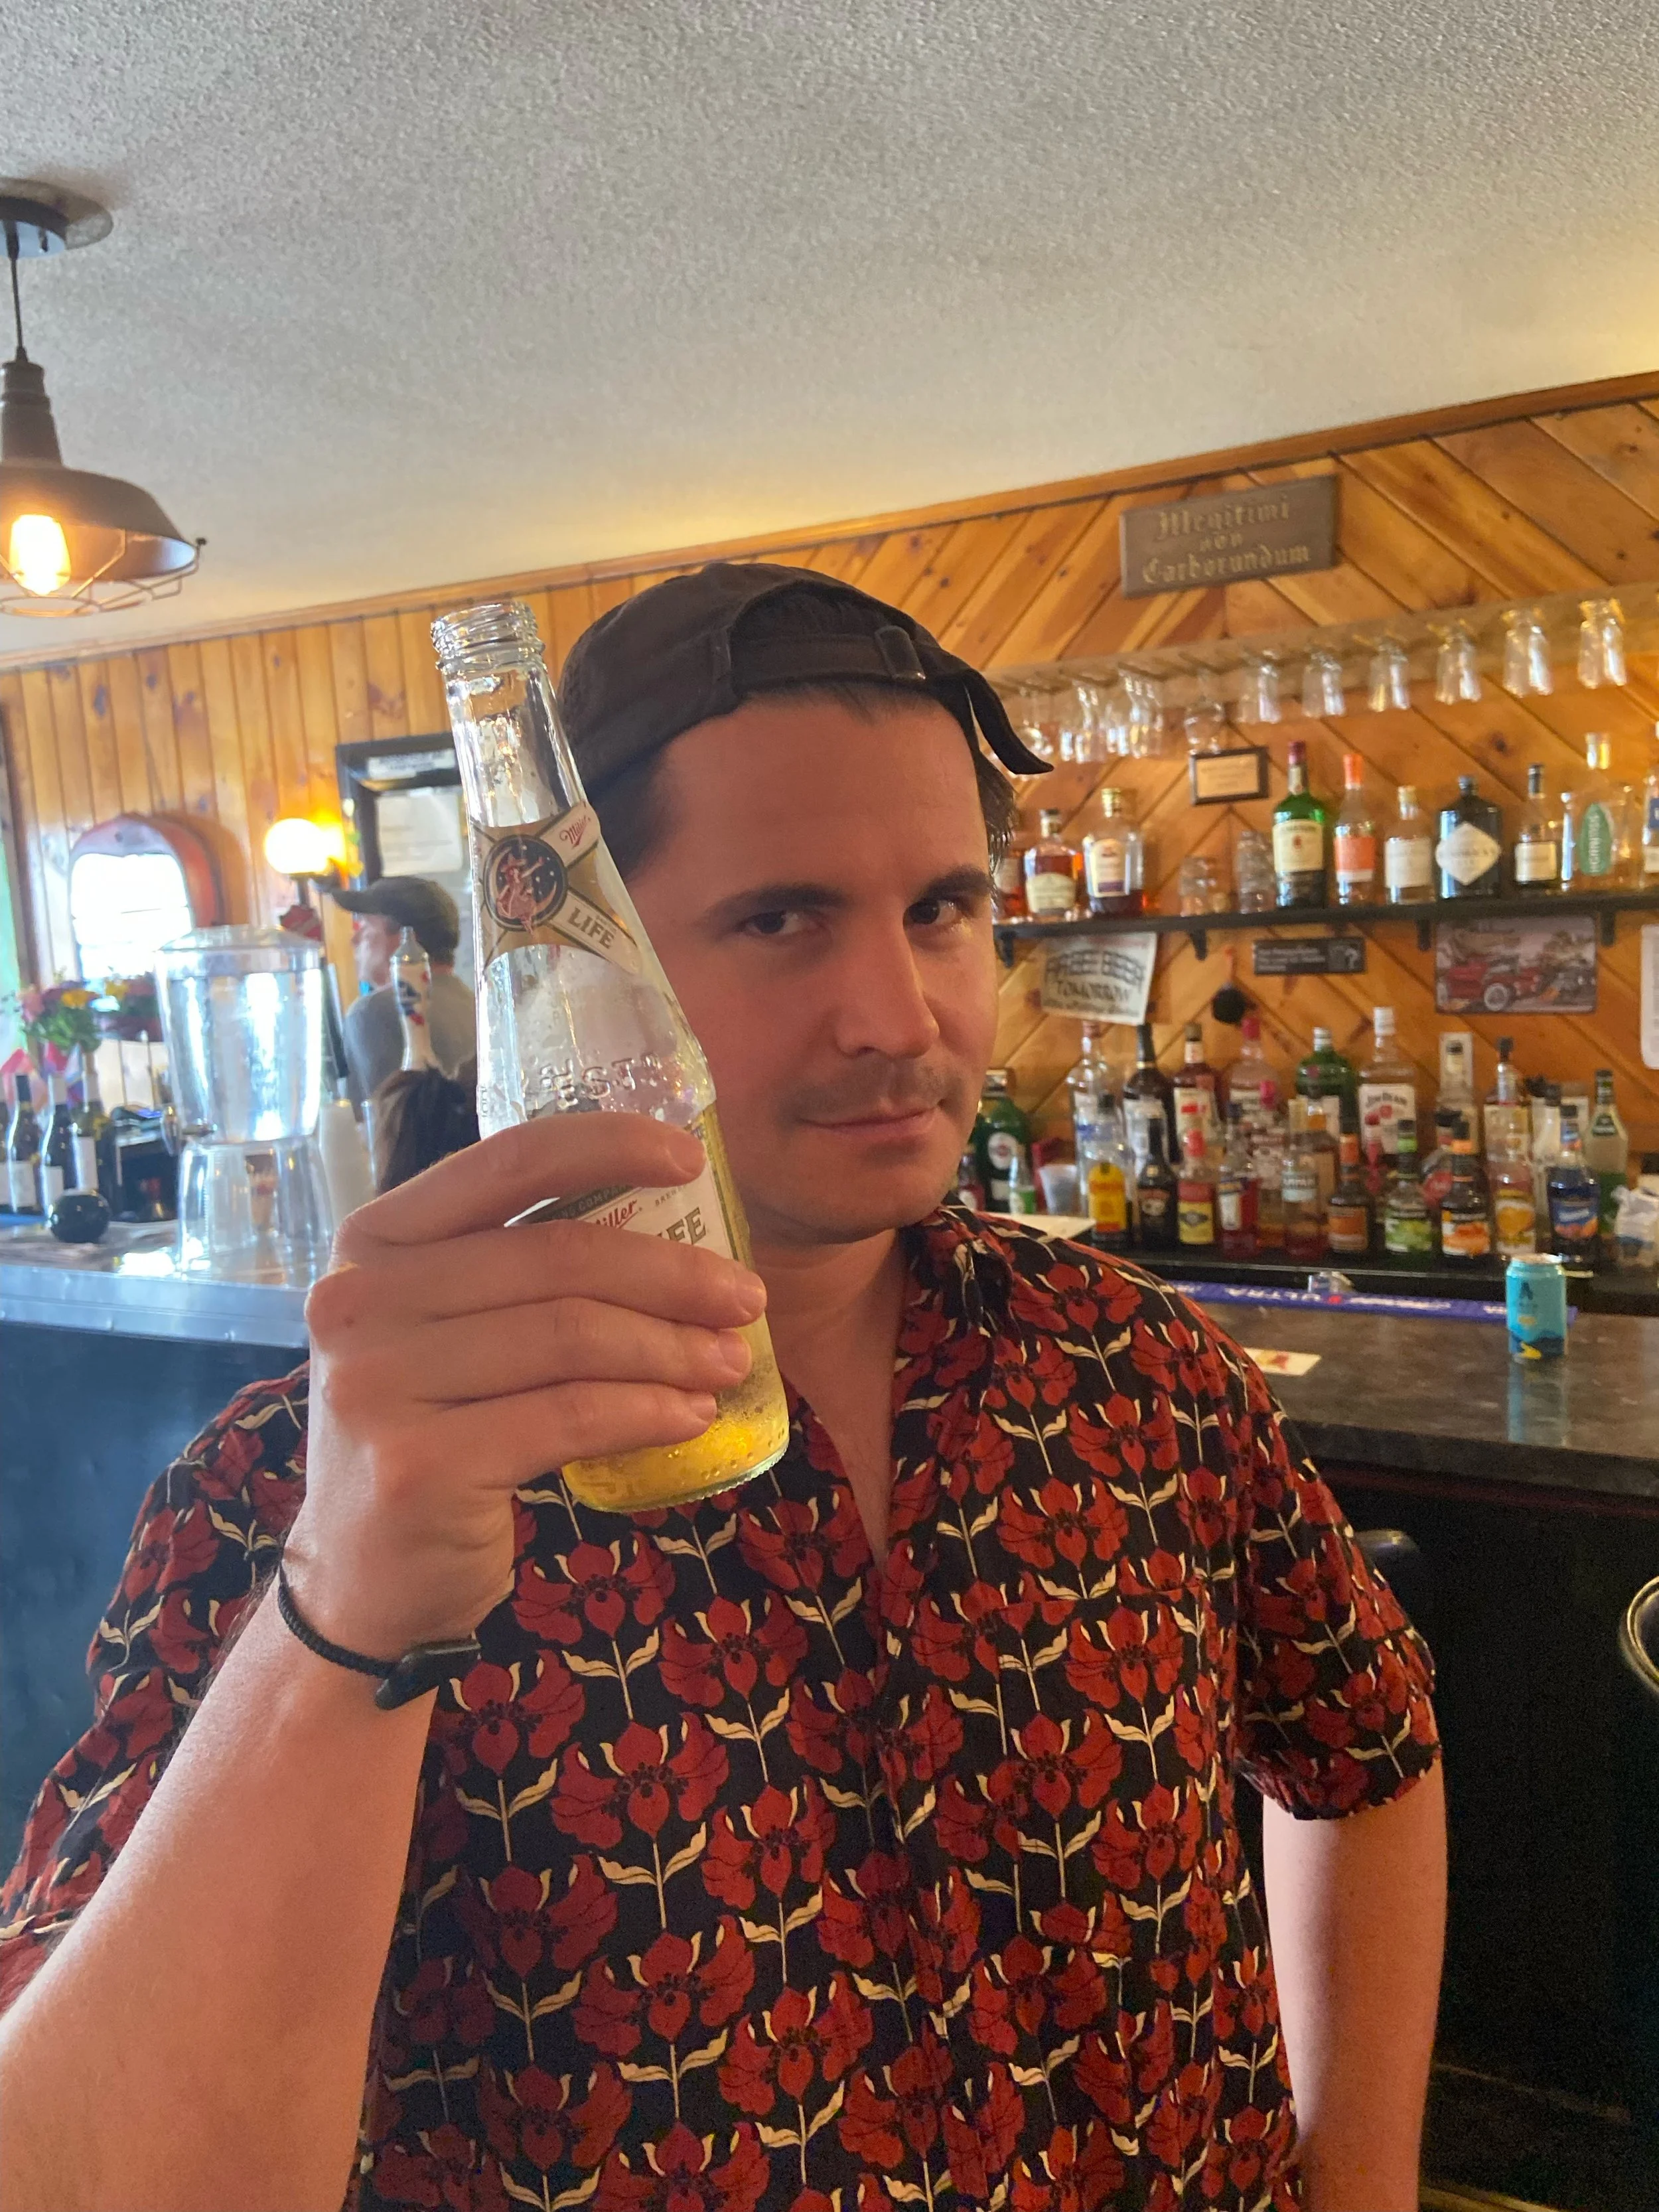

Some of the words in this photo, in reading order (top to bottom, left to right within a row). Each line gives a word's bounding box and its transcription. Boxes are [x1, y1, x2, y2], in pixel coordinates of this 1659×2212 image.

[1142, 543, 1312, 584] Carborundum
[559, 815, 591, 848] Miller
[567, 906, 615, 950] LIFE
[1101, 950, 1145, 994] BEER
[1224, 1287, 1322, 1303] ULTRA
